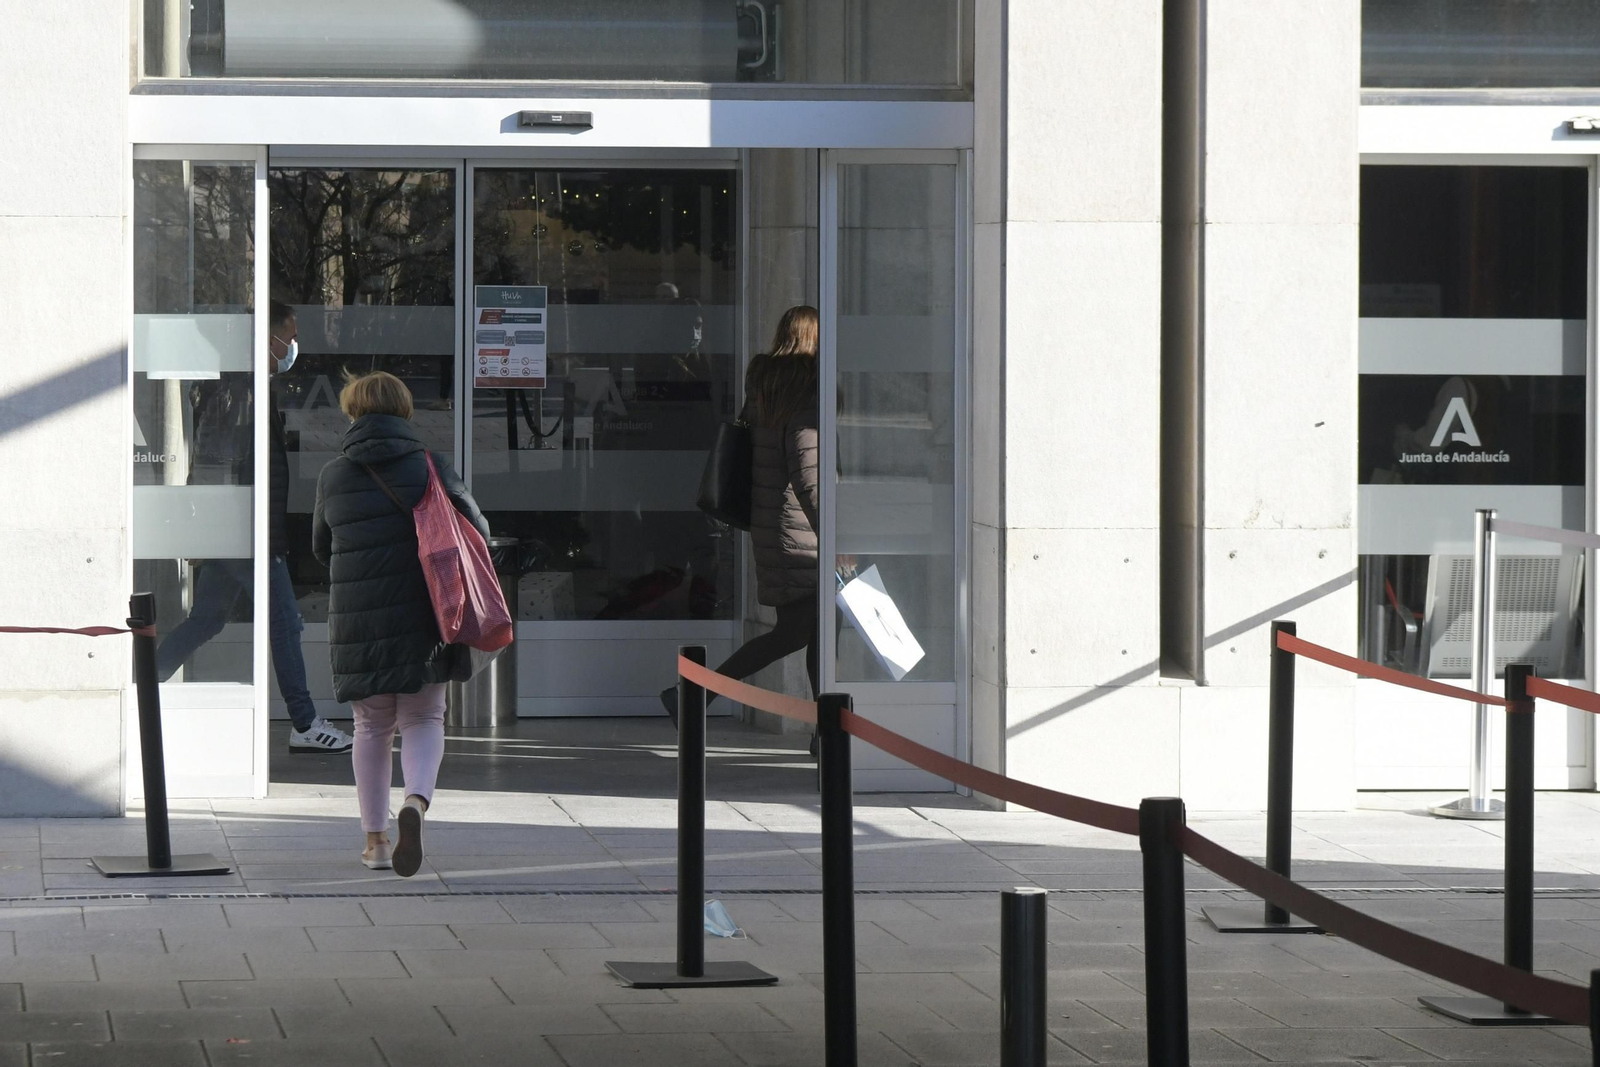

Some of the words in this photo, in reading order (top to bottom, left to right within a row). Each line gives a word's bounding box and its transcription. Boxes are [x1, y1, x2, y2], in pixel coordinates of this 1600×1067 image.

[133, 451, 177, 463] daluca
[1399, 452, 1433, 463] Junta
[1434, 452, 1450, 463] de
[1451, 449, 1511, 463] Andalucía
